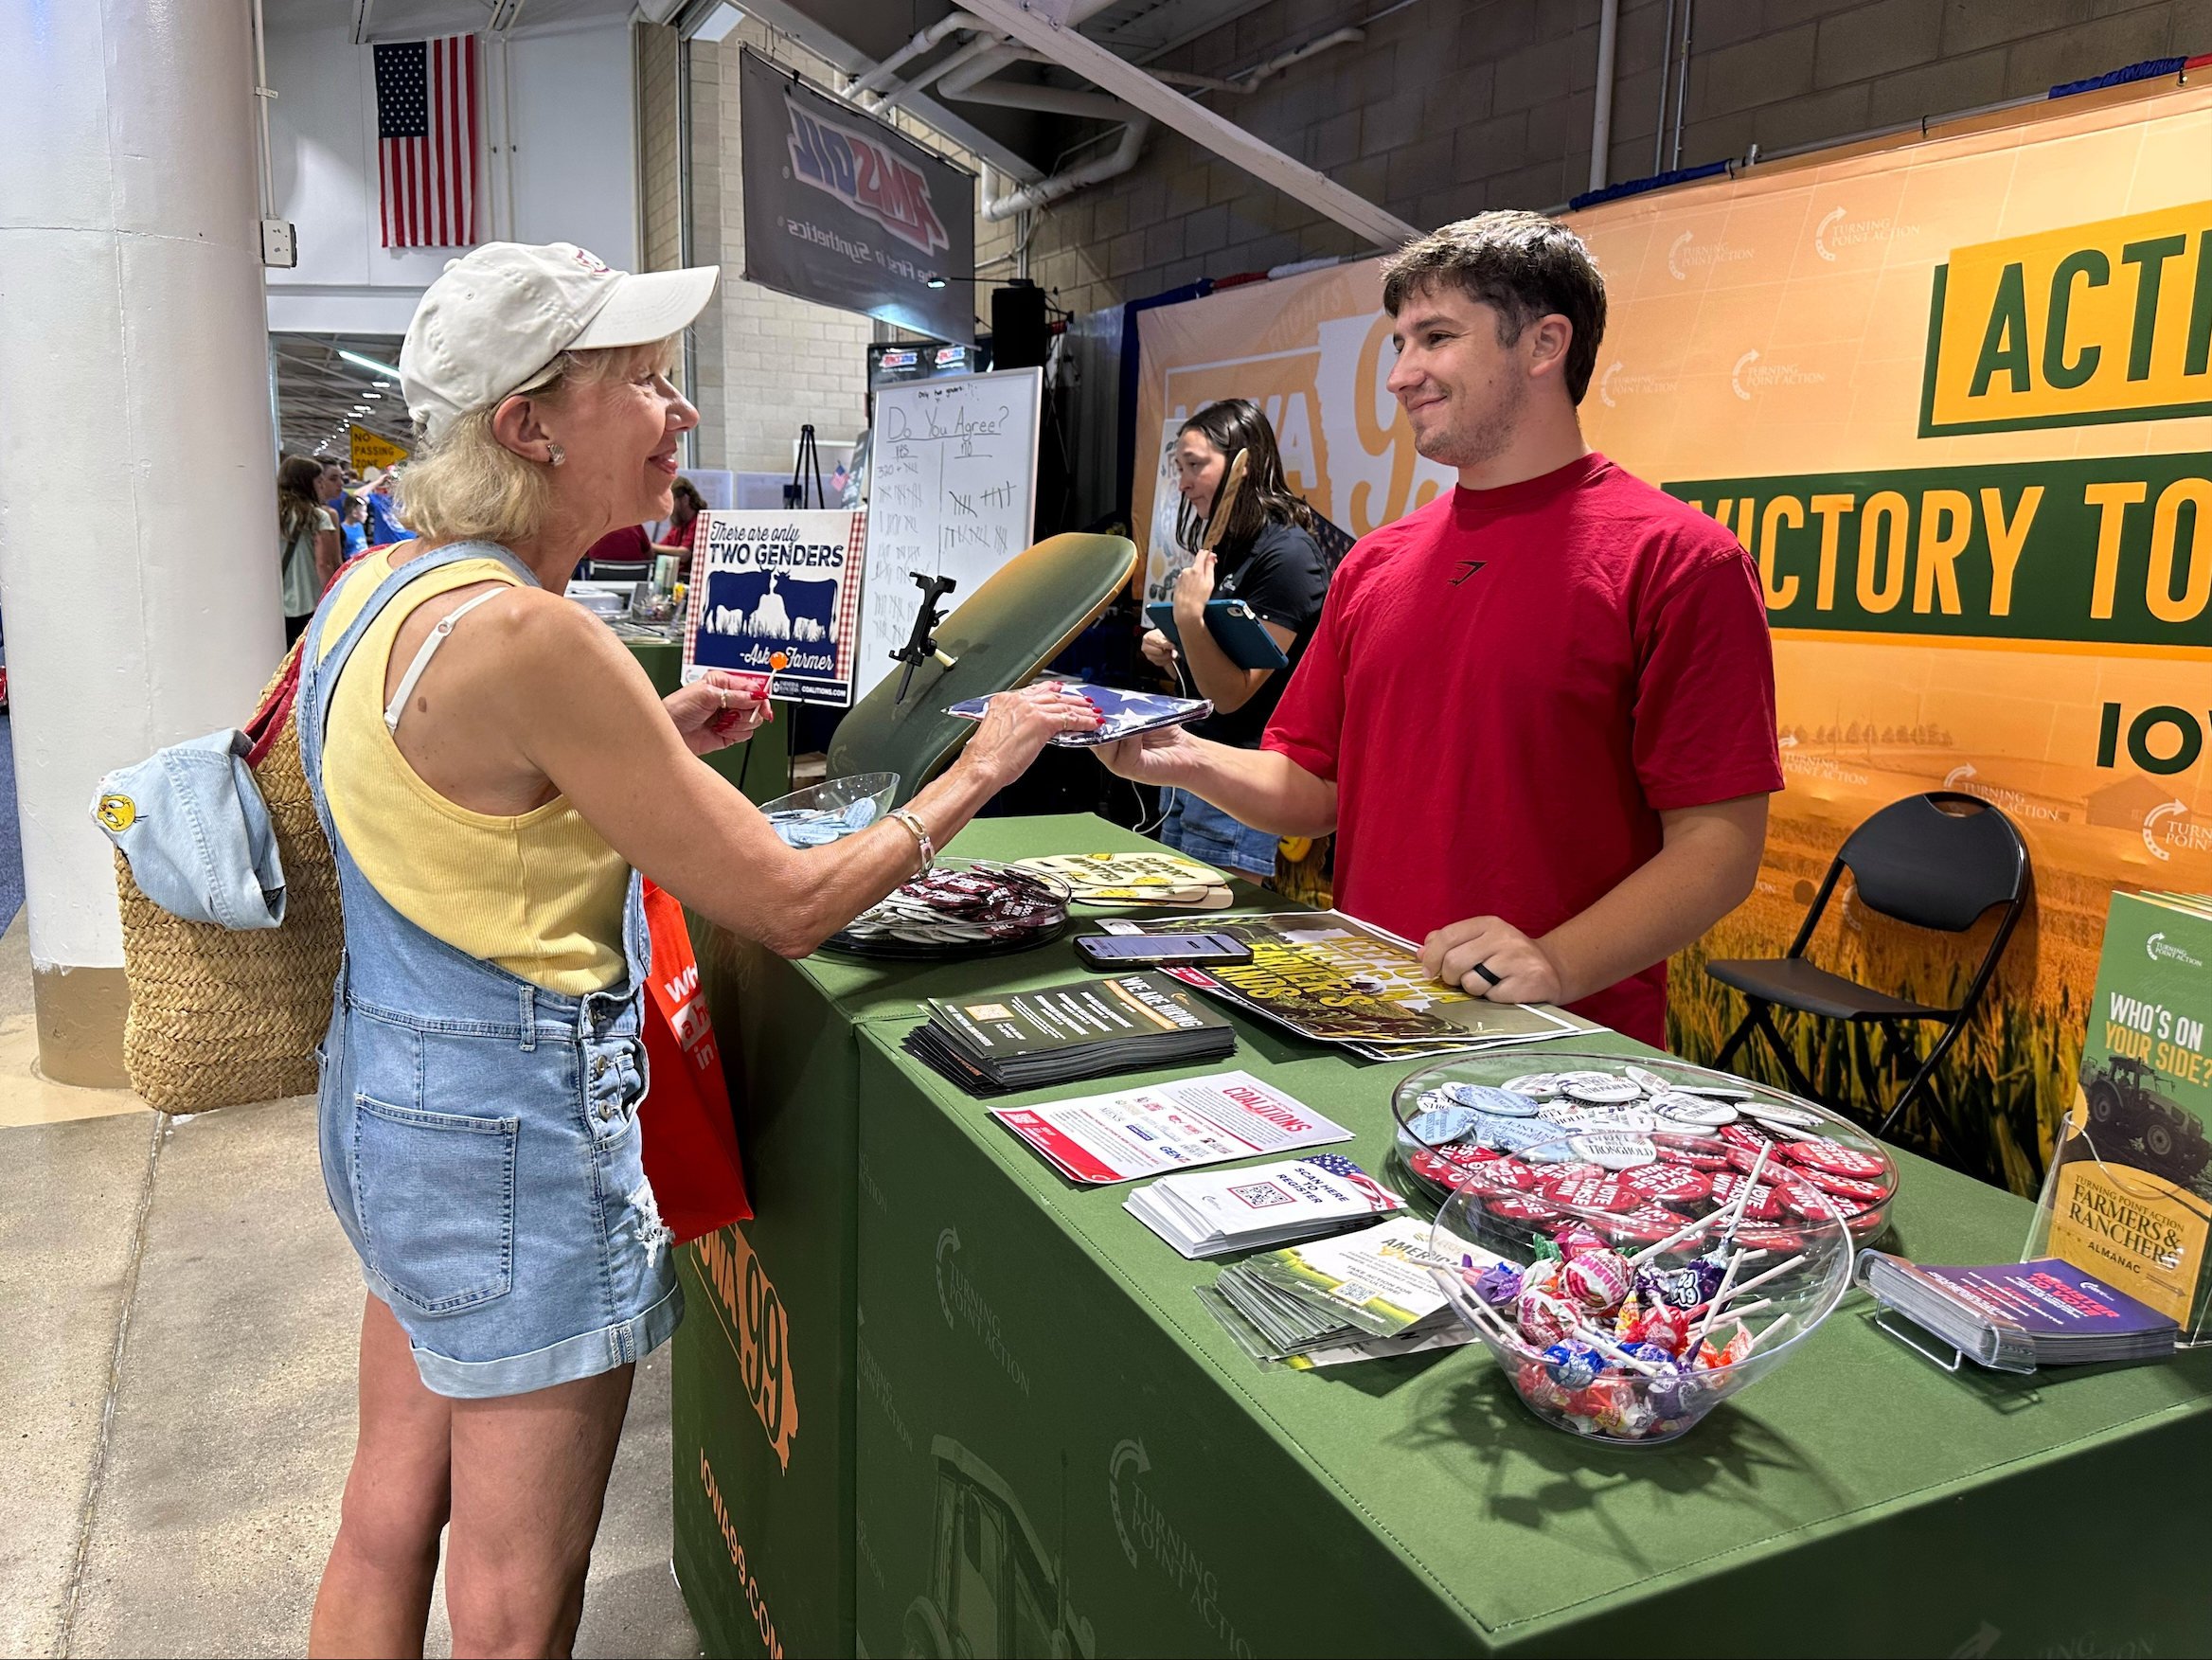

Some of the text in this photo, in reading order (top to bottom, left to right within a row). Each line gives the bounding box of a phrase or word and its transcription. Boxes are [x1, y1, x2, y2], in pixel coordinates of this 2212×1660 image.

[1831, 224, 1919, 247] POINT ACTION
[1833, 218, 1891, 236] TURNING
[1682, 248, 1754, 267] POINT ACTION
[1683, 242, 1730, 259] TURNING
[1613, 374, 1655, 386] TURNING
[1746, 372, 1825, 386] POINT ACTION
[1748, 365, 1798, 378] TURNING
[1641, 381, 1677, 393] ACTION
[888, 405, 1009, 442] Do You Agree?
[354, 434, 370, 442] NO
[354, 446, 394, 456] PASSING
[711, 521, 800, 546] There are only
[710, 544, 844, 568] TWO GENDERS
[2084, 477, 2212, 622] TO
[785, 646, 834, 671] Farmer
[2096, 702, 2212, 775] IO
[1782, 762, 1868, 786] POINT ACTION
[1784, 753, 1839, 771] TURNING
[1963, 782, 2025, 805] TURNING
[1323, 936, 1416, 962] KEEP
[2155, 941, 2186, 956] TURNING
[2155, 947, 2203, 967] POINT ACTION
[1204, 965, 1302, 999] ANDS
[1152, 1003, 1204, 1027] HIRING
[2110, 991, 2204, 1052] WHO'S ON
[681, 1020, 695, 1040] a
[693, 1044, 715, 1071] in
[2105, 1021, 2212, 1087] YOUR SIDE?
[1219, 1086, 1314, 1133] COALITIONS
[1806, 1142, 1839, 1165] VOTE
[1822, 1139, 1863, 1172] CHASE
[1846, 1148, 1875, 1169] WIN
[1628, 1161, 1670, 1179] WIN
[1629, 1165, 1690, 1189] CHASE
[1275, 1173, 1324, 1204] REGISTER
[1293, 1168, 1350, 1202] SCAN HERE
[1300, 1182, 1320, 1190] TO
[1555, 1180, 1579, 1197] WIN
[1572, 1178, 1601, 1205] CHASE
[1594, 1184, 1620, 1205] VOTE
[1660, 1175, 1696, 1196] VOTE
[1712, 1173, 1728, 1193] WIN
[1746, 1185, 1773, 1210] VOTE
[2075, 1174, 2185, 1232] TURNING POINT ACTION
[2072, 1184, 2182, 1250] FARMERS &
[2069, 1202, 2179, 1268] RANCHERS
[2088, 1241, 2142, 1275] ALMANAC
[1365, 1273, 1395, 1287] ACTION
[1571, 1253, 1625, 1304] CHARMS
[949, 1259, 1001, 1339] TURNING
[2022, 1276, 2055, 1289] TO
[2046, 1290, 2103, 1316] VOTE
[2029, 1272, 2124, 1317] REGISTER
[949, 1280, 1030, 1399] POINT ACTION
[881, 1392, 913, 1453] ACTION
[700, 1446, 784, 1659] IOWA99.COM
[1132, 1480, 1219, 1602] TURNING
[1131, 1506, 1258, 1659] POINT ACTIO
